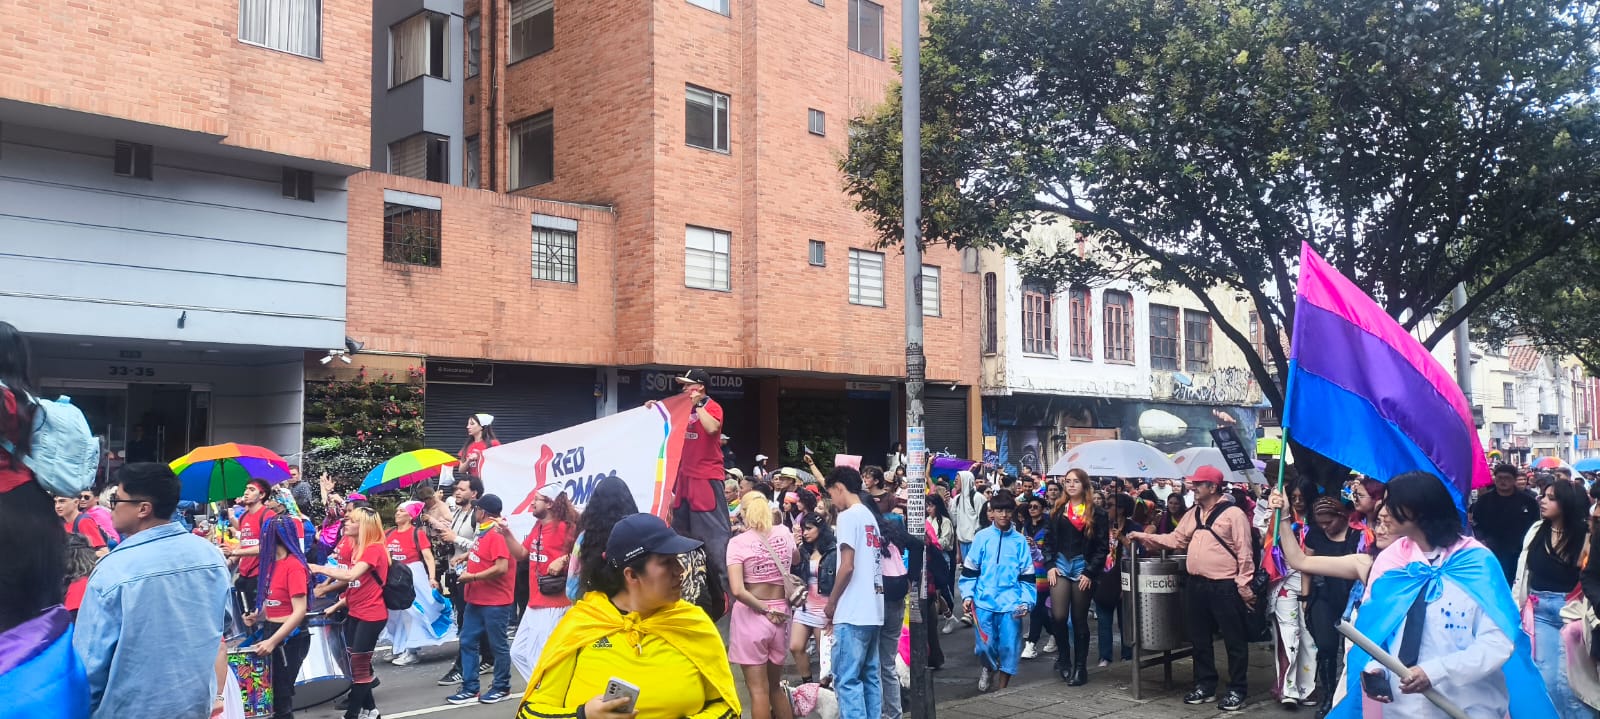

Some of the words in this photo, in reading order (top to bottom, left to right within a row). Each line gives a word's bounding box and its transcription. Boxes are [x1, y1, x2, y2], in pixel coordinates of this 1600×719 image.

[109, 366, 155, 377] 33-35
[710, 375, 743, 387] CIDAD
[551, 446, 586, 477] RED
[1145, 580, 1178, 588] RECICL
